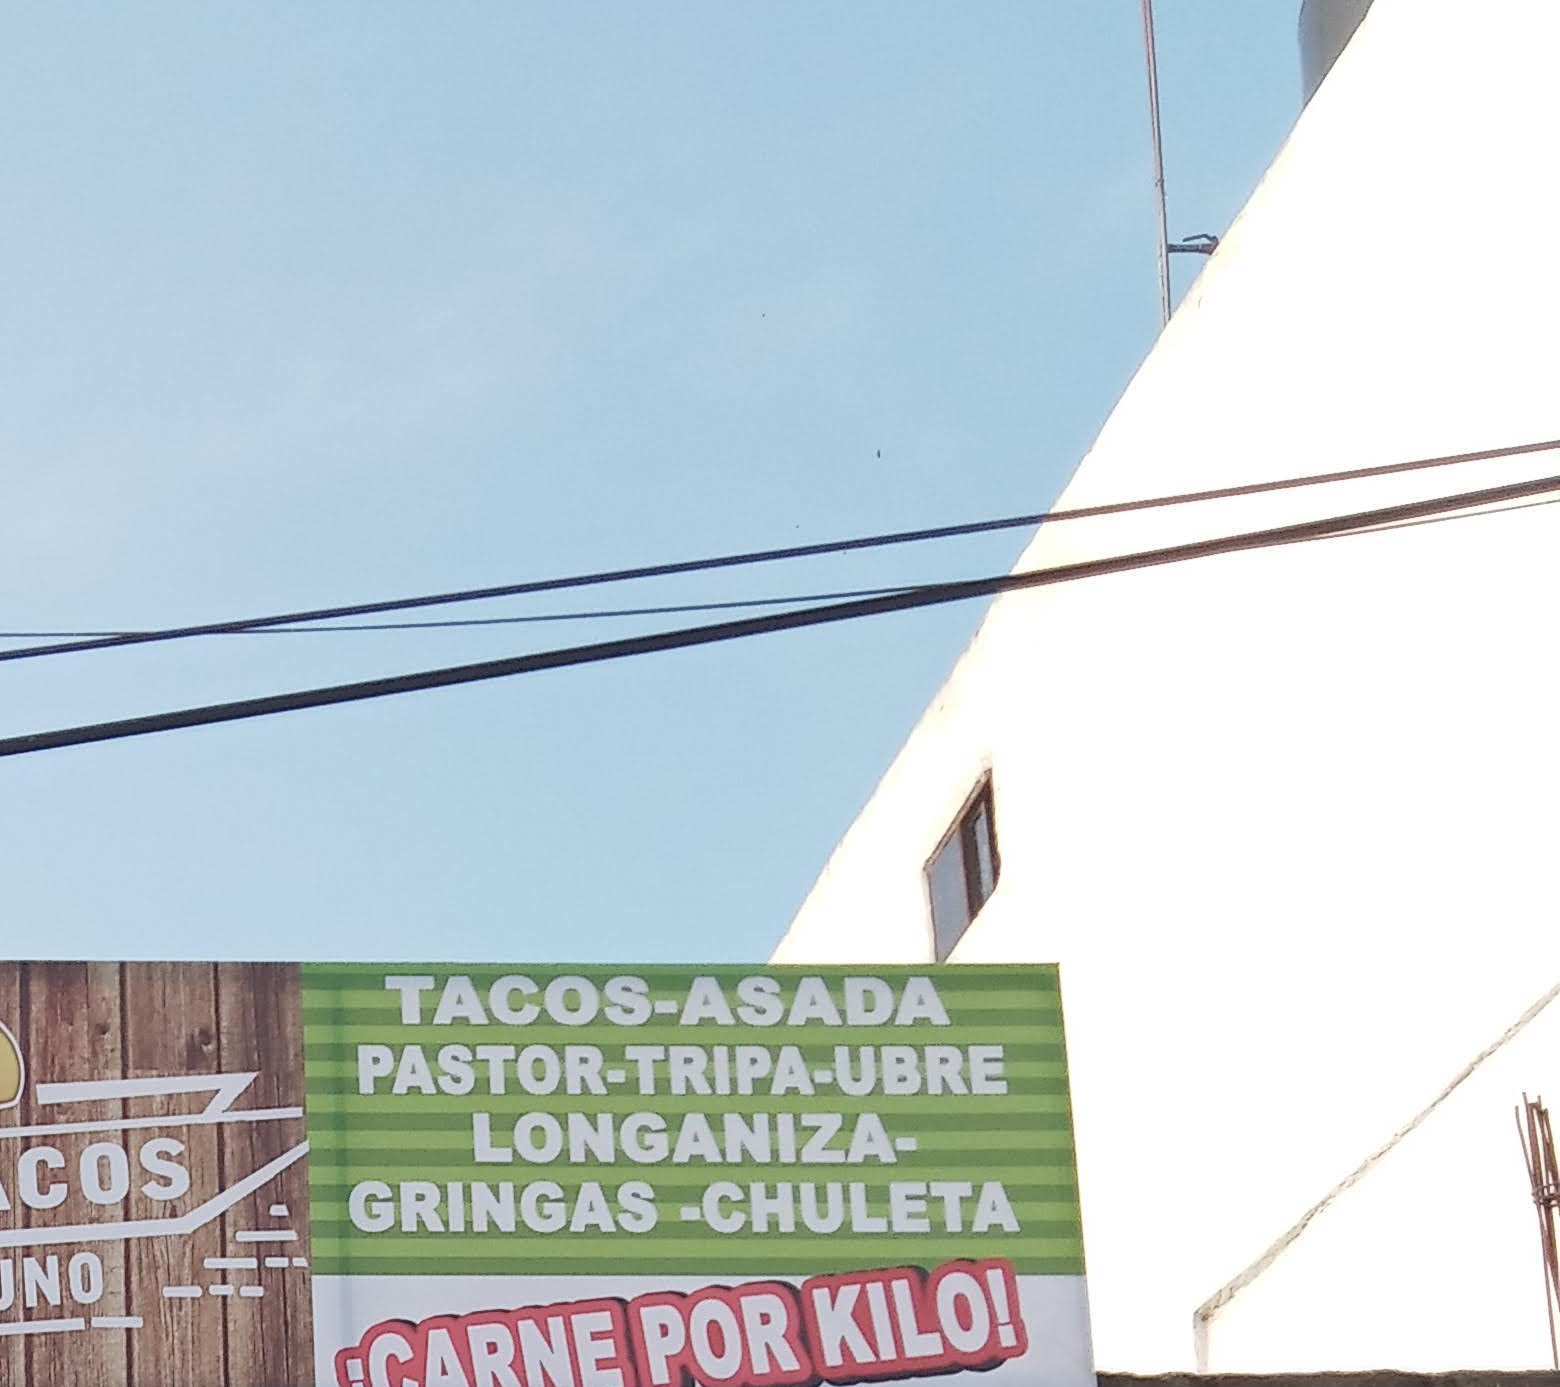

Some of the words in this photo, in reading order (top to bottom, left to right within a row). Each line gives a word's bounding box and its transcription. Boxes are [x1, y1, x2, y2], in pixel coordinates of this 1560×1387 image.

[385, 976, 950, 1026] TACOS-ASADA
[357, 1045, 1008, 1096] PASTOR-TRIPA-UBRE
[472, 1113, 917, 1165] LONGANIZA-
[348, 1181, 657, 1233] GRINGAS
[639, 1293, 800, 1386] POR
[812, 1267, 1019, 1368] KILO!
